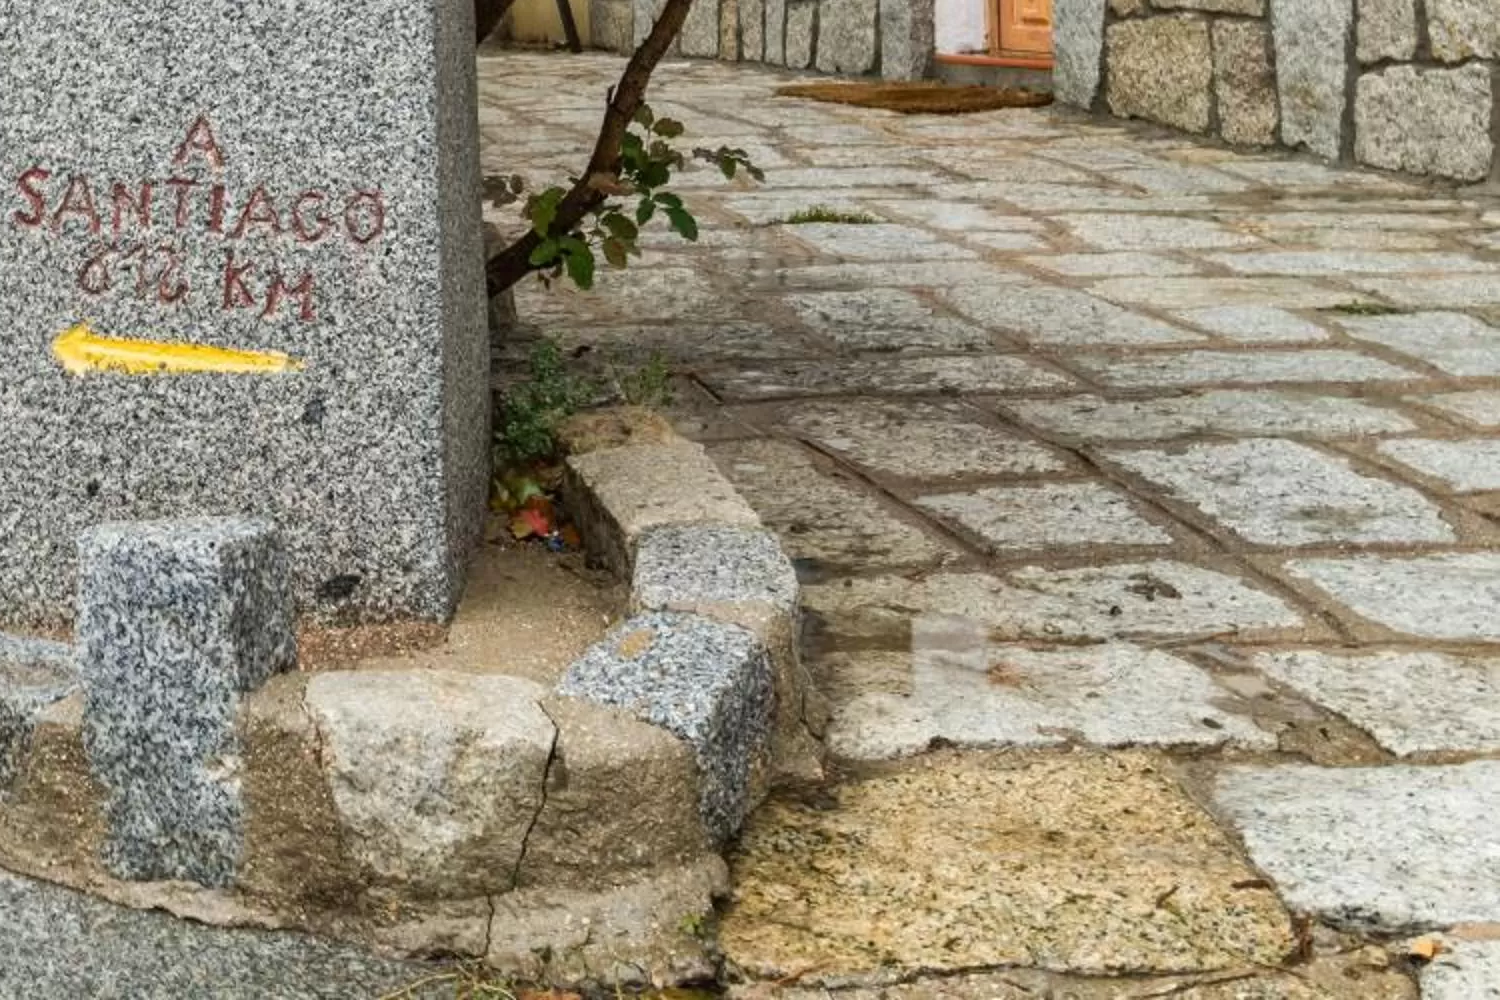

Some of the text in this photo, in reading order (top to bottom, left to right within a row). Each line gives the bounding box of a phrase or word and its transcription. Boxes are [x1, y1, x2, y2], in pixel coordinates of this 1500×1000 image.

[172, 112, 226, 170] A
[13, 164, 387, 247] SANTIAGO
[220, 248, 318, 323] KM
